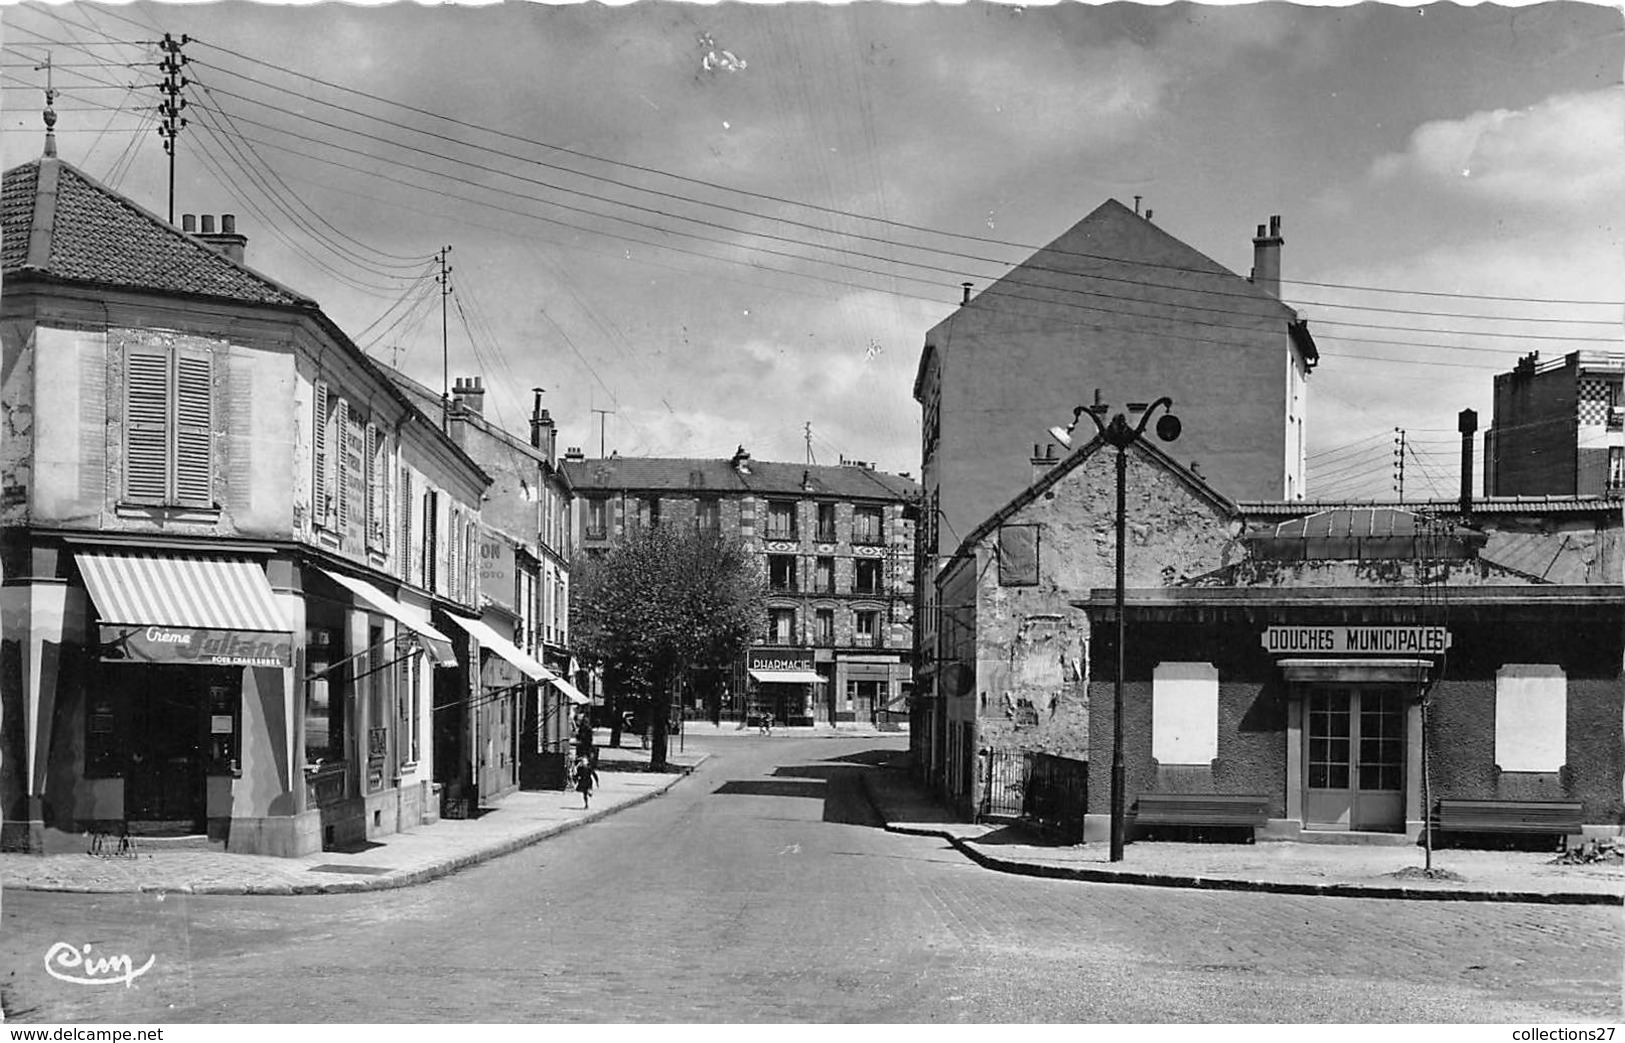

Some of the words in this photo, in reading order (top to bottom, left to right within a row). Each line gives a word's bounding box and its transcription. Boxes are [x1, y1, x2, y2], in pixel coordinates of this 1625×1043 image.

[481, 544, 500, 559] ON
[1269, 629, 1334, 650] DOUCHES
[1346, 629, 1444, 651] MUNICIPALES
[212, 656, 231, 664] POUR
[753, 659, 810, 670] PHARMACIE
